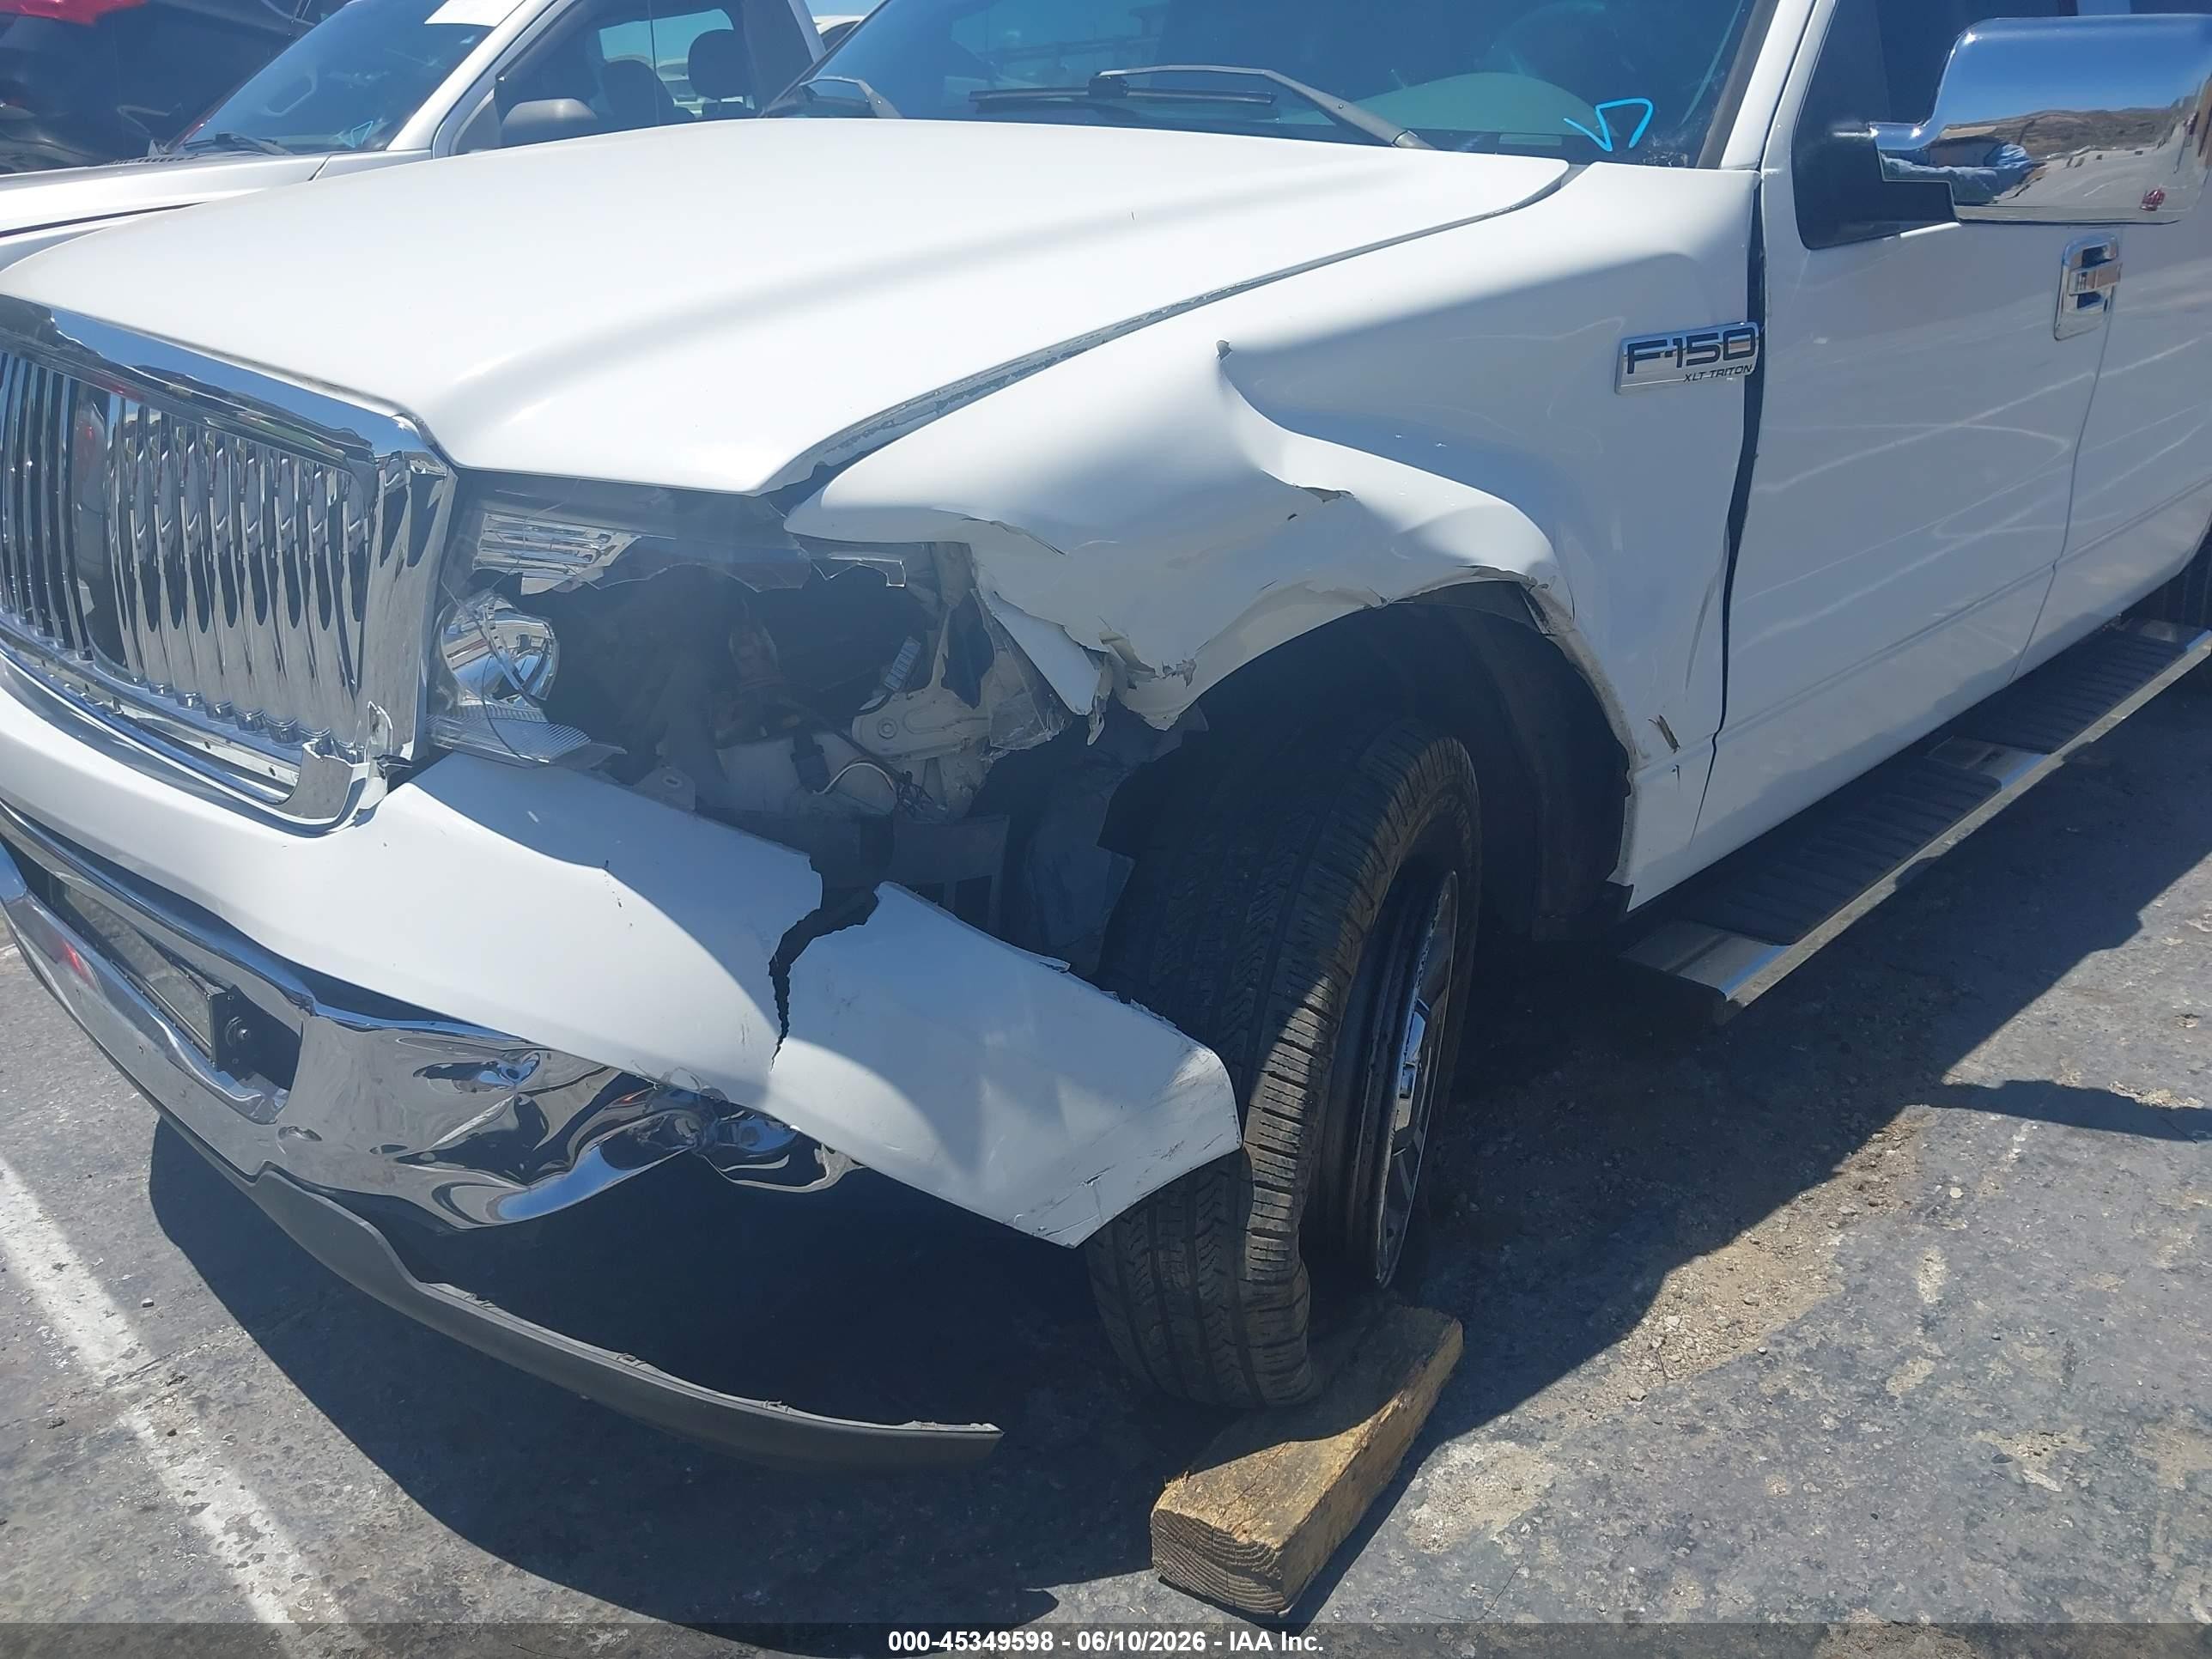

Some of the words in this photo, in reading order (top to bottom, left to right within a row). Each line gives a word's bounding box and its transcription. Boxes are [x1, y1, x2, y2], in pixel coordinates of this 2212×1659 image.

[1627, 327, 1756, 374] F-150
[1683, 371, 1707, 383] XLT
[1710, 364, 1753, 379] TRITON
